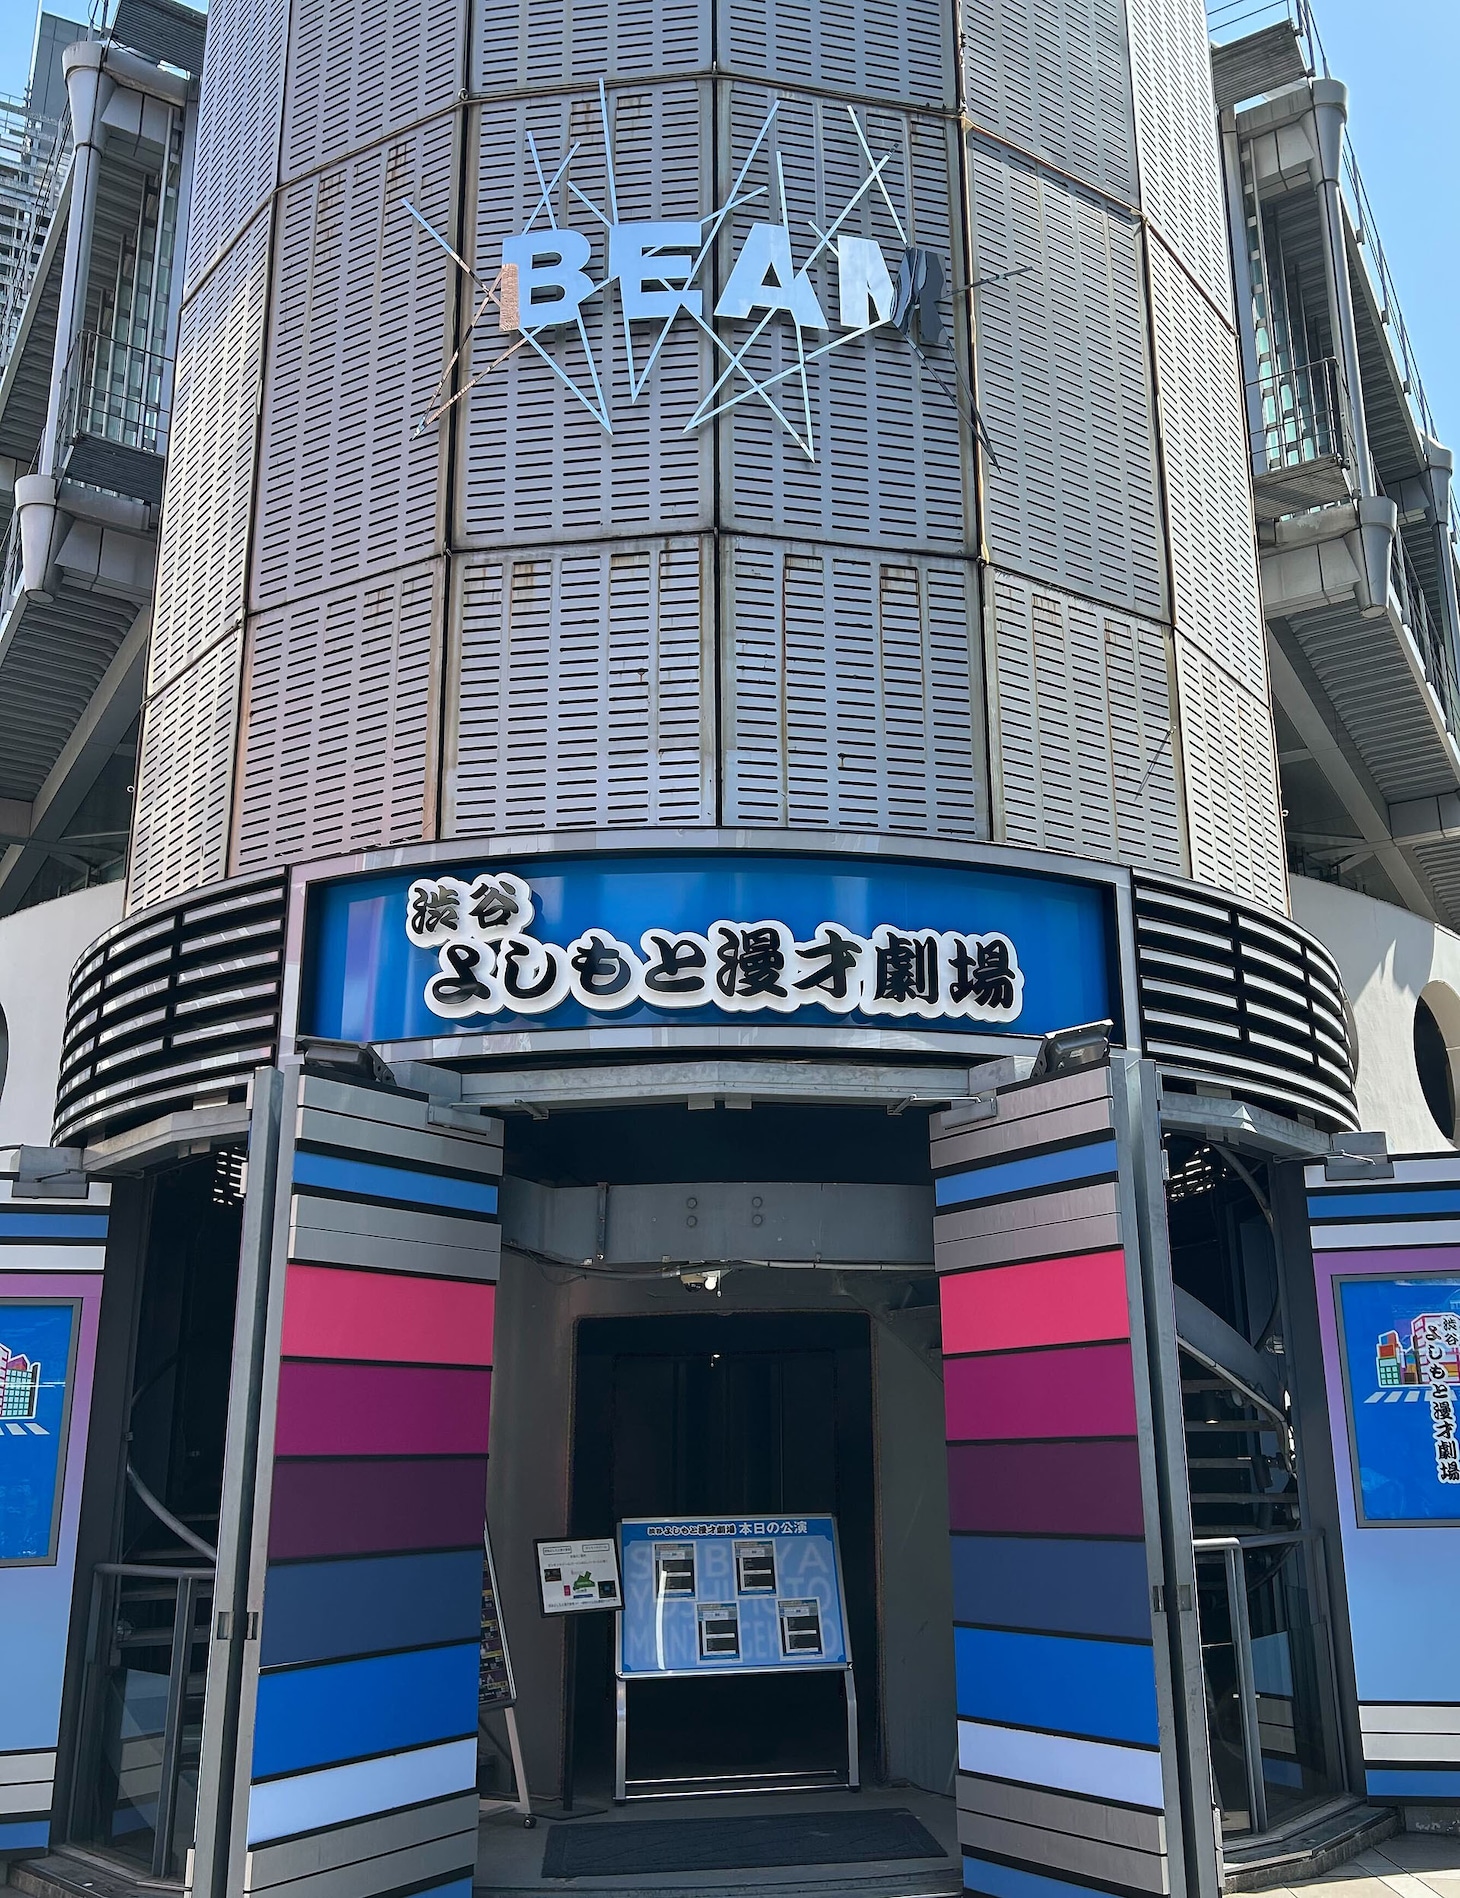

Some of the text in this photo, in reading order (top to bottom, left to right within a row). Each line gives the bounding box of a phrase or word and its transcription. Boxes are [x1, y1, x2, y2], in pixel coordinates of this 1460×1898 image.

[499, 222, 946, 343] BEAM
[412, 881, 519, 934] 渋谷
[434, 928, 1016, 1006] よしもと漫才劇場
[1443, 1317, 1459, 1346] 渋谷
[1426, 1325, 1460, 1481] よしもと漫才劇場
[739, 1520, 808, 1535] 本日の公演
